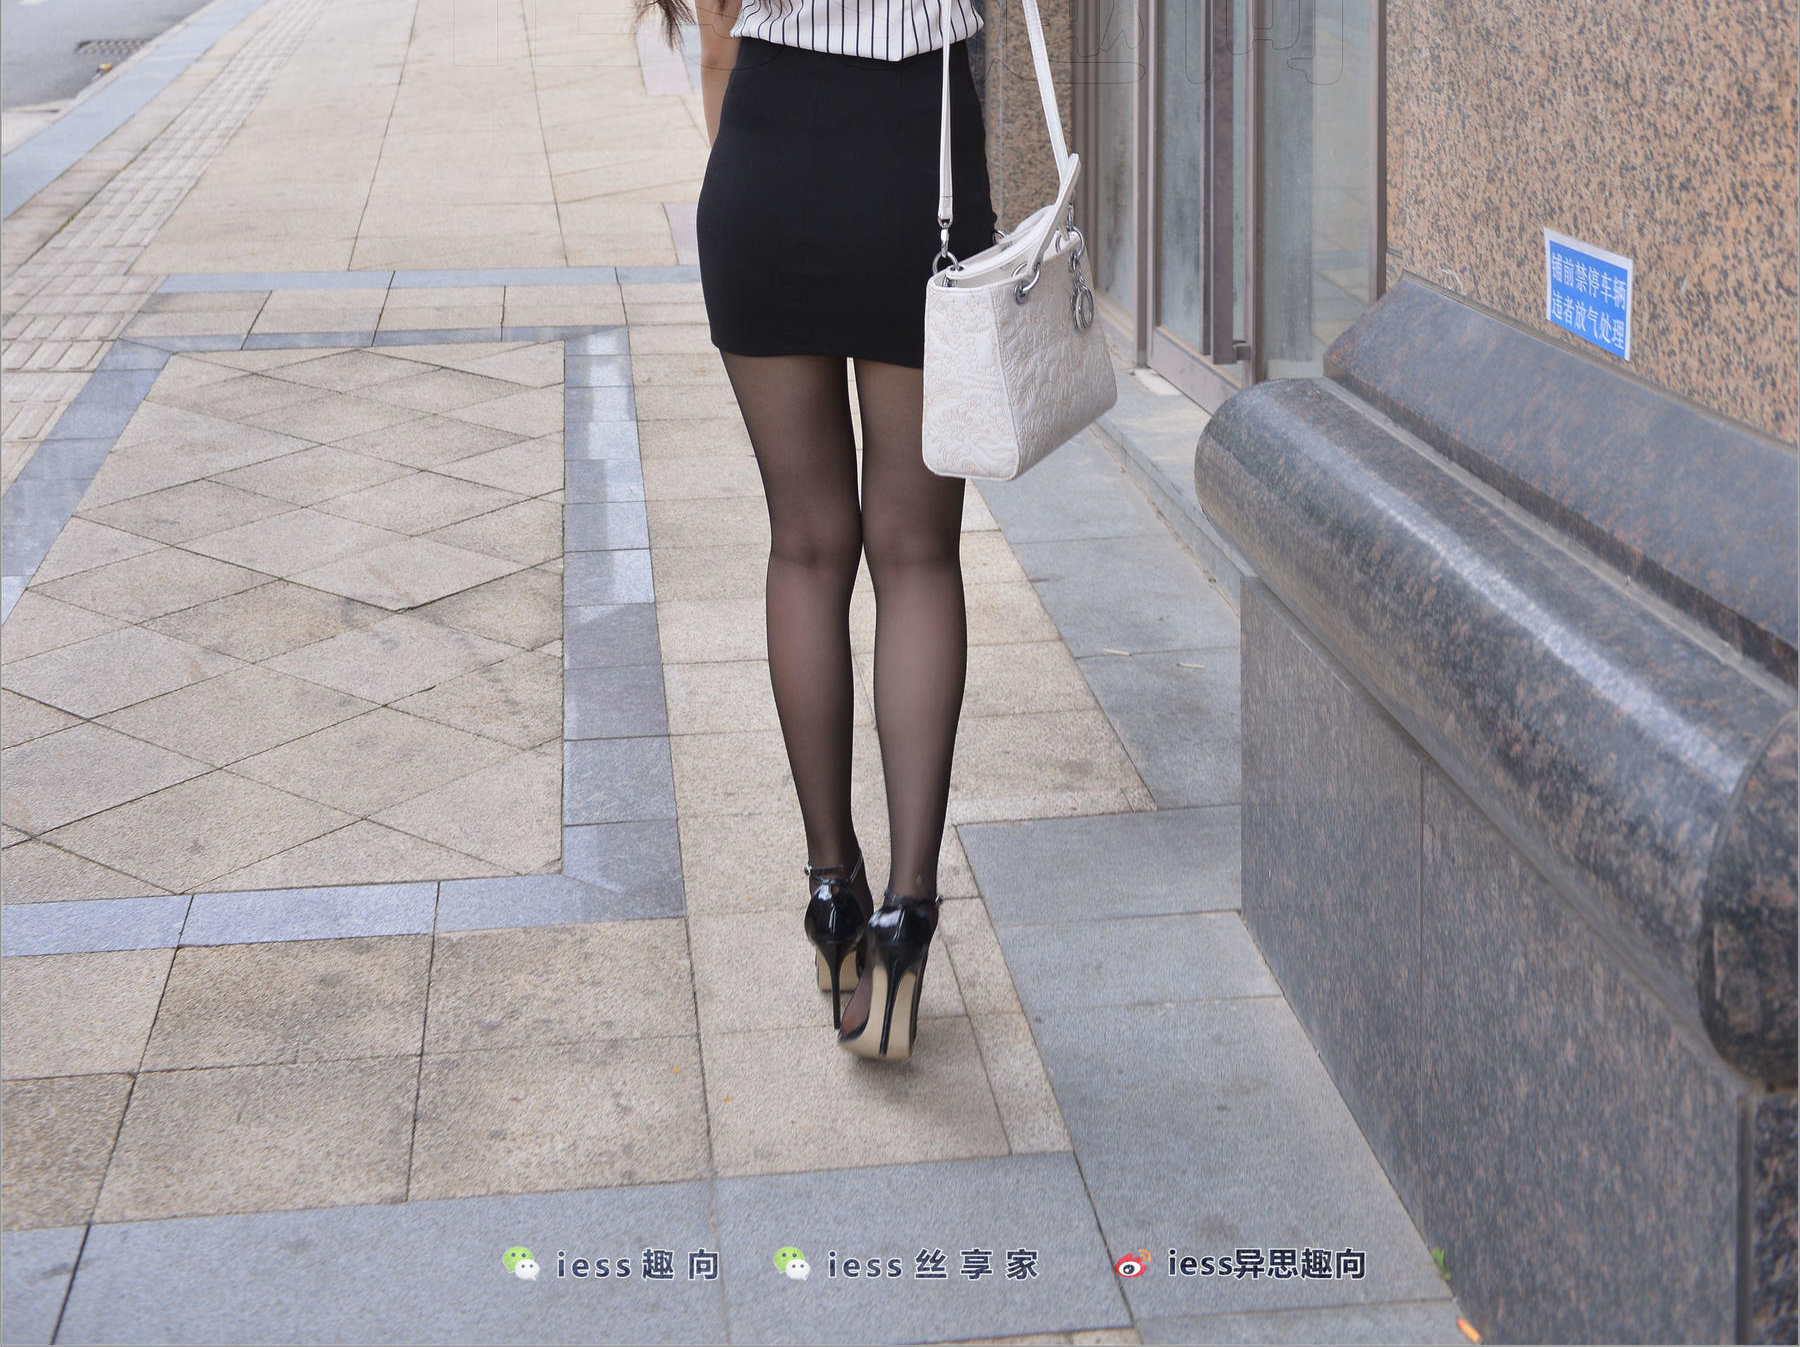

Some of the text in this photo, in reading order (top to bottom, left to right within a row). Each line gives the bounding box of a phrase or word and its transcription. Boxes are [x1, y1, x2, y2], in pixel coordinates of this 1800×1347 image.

[1551, 290, 1625, 350] 违者放气处理
